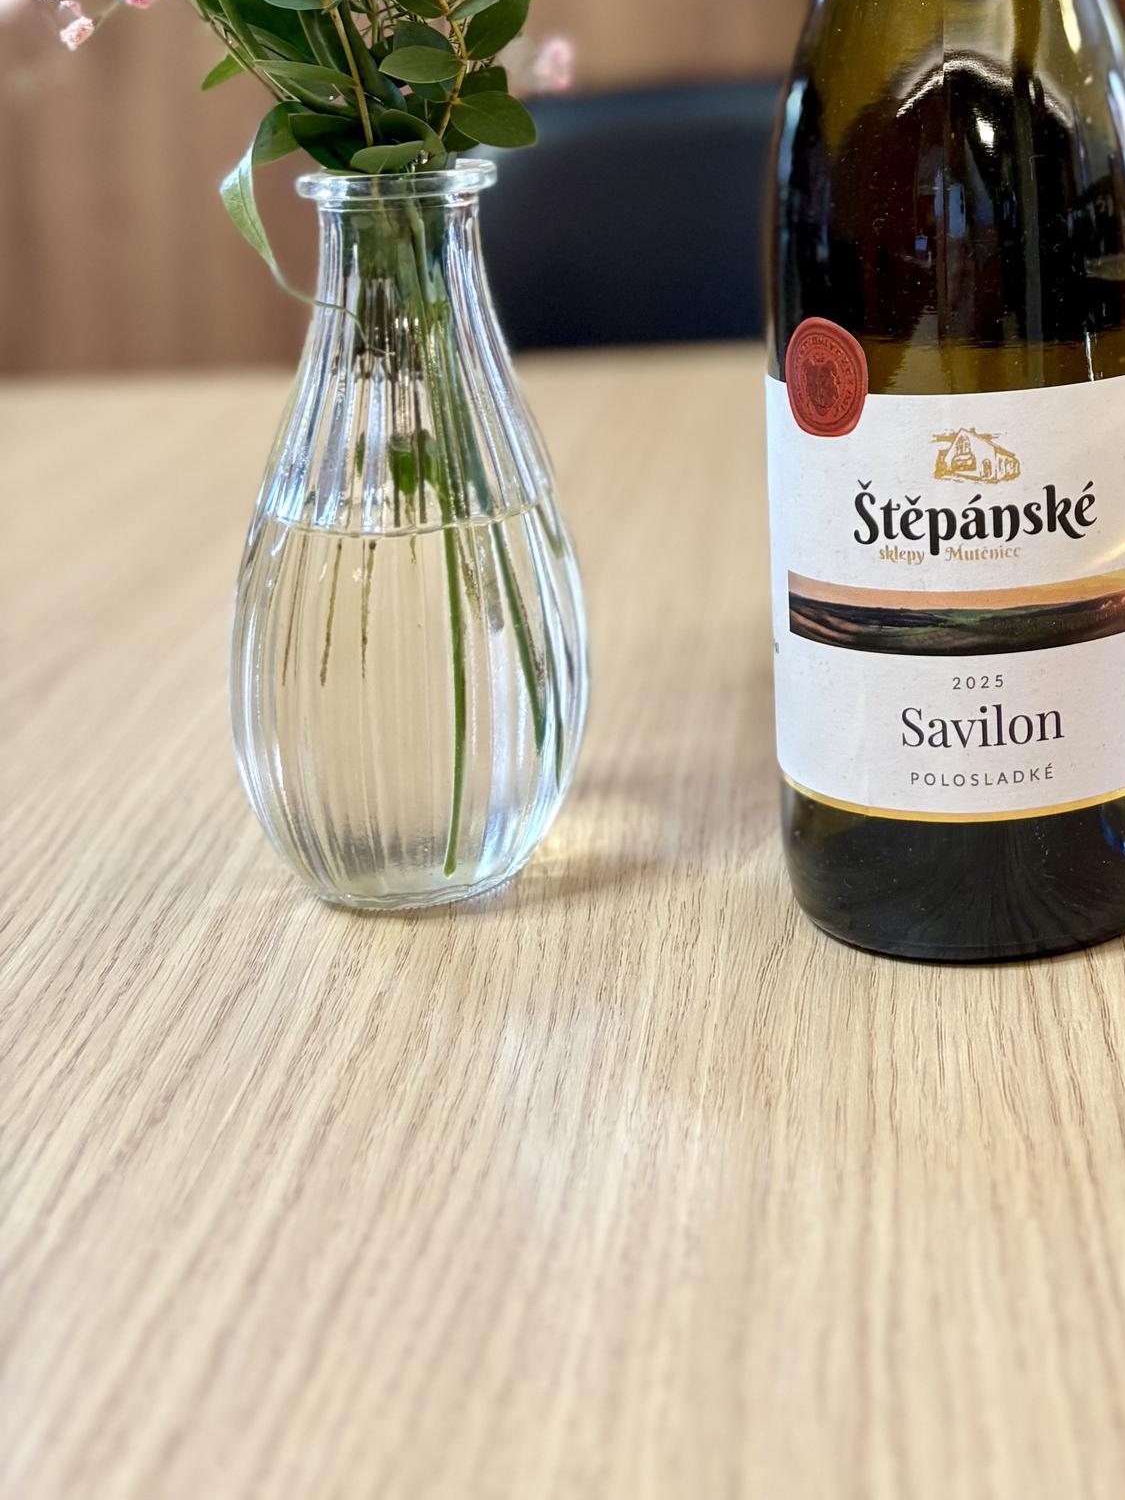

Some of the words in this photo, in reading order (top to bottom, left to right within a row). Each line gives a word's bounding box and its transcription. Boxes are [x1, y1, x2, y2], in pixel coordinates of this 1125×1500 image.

[853, 478, 1098, 556] Štěpánské
[879, 545, 925, 565] sklepy
[945, 544, 1021, 563] Mutěnice
[953, 674, 1004, 690] 2025
[901, 703, 1065, 749] Savilon
[910, 762, 1054, 787] POLOSLADKÉ
